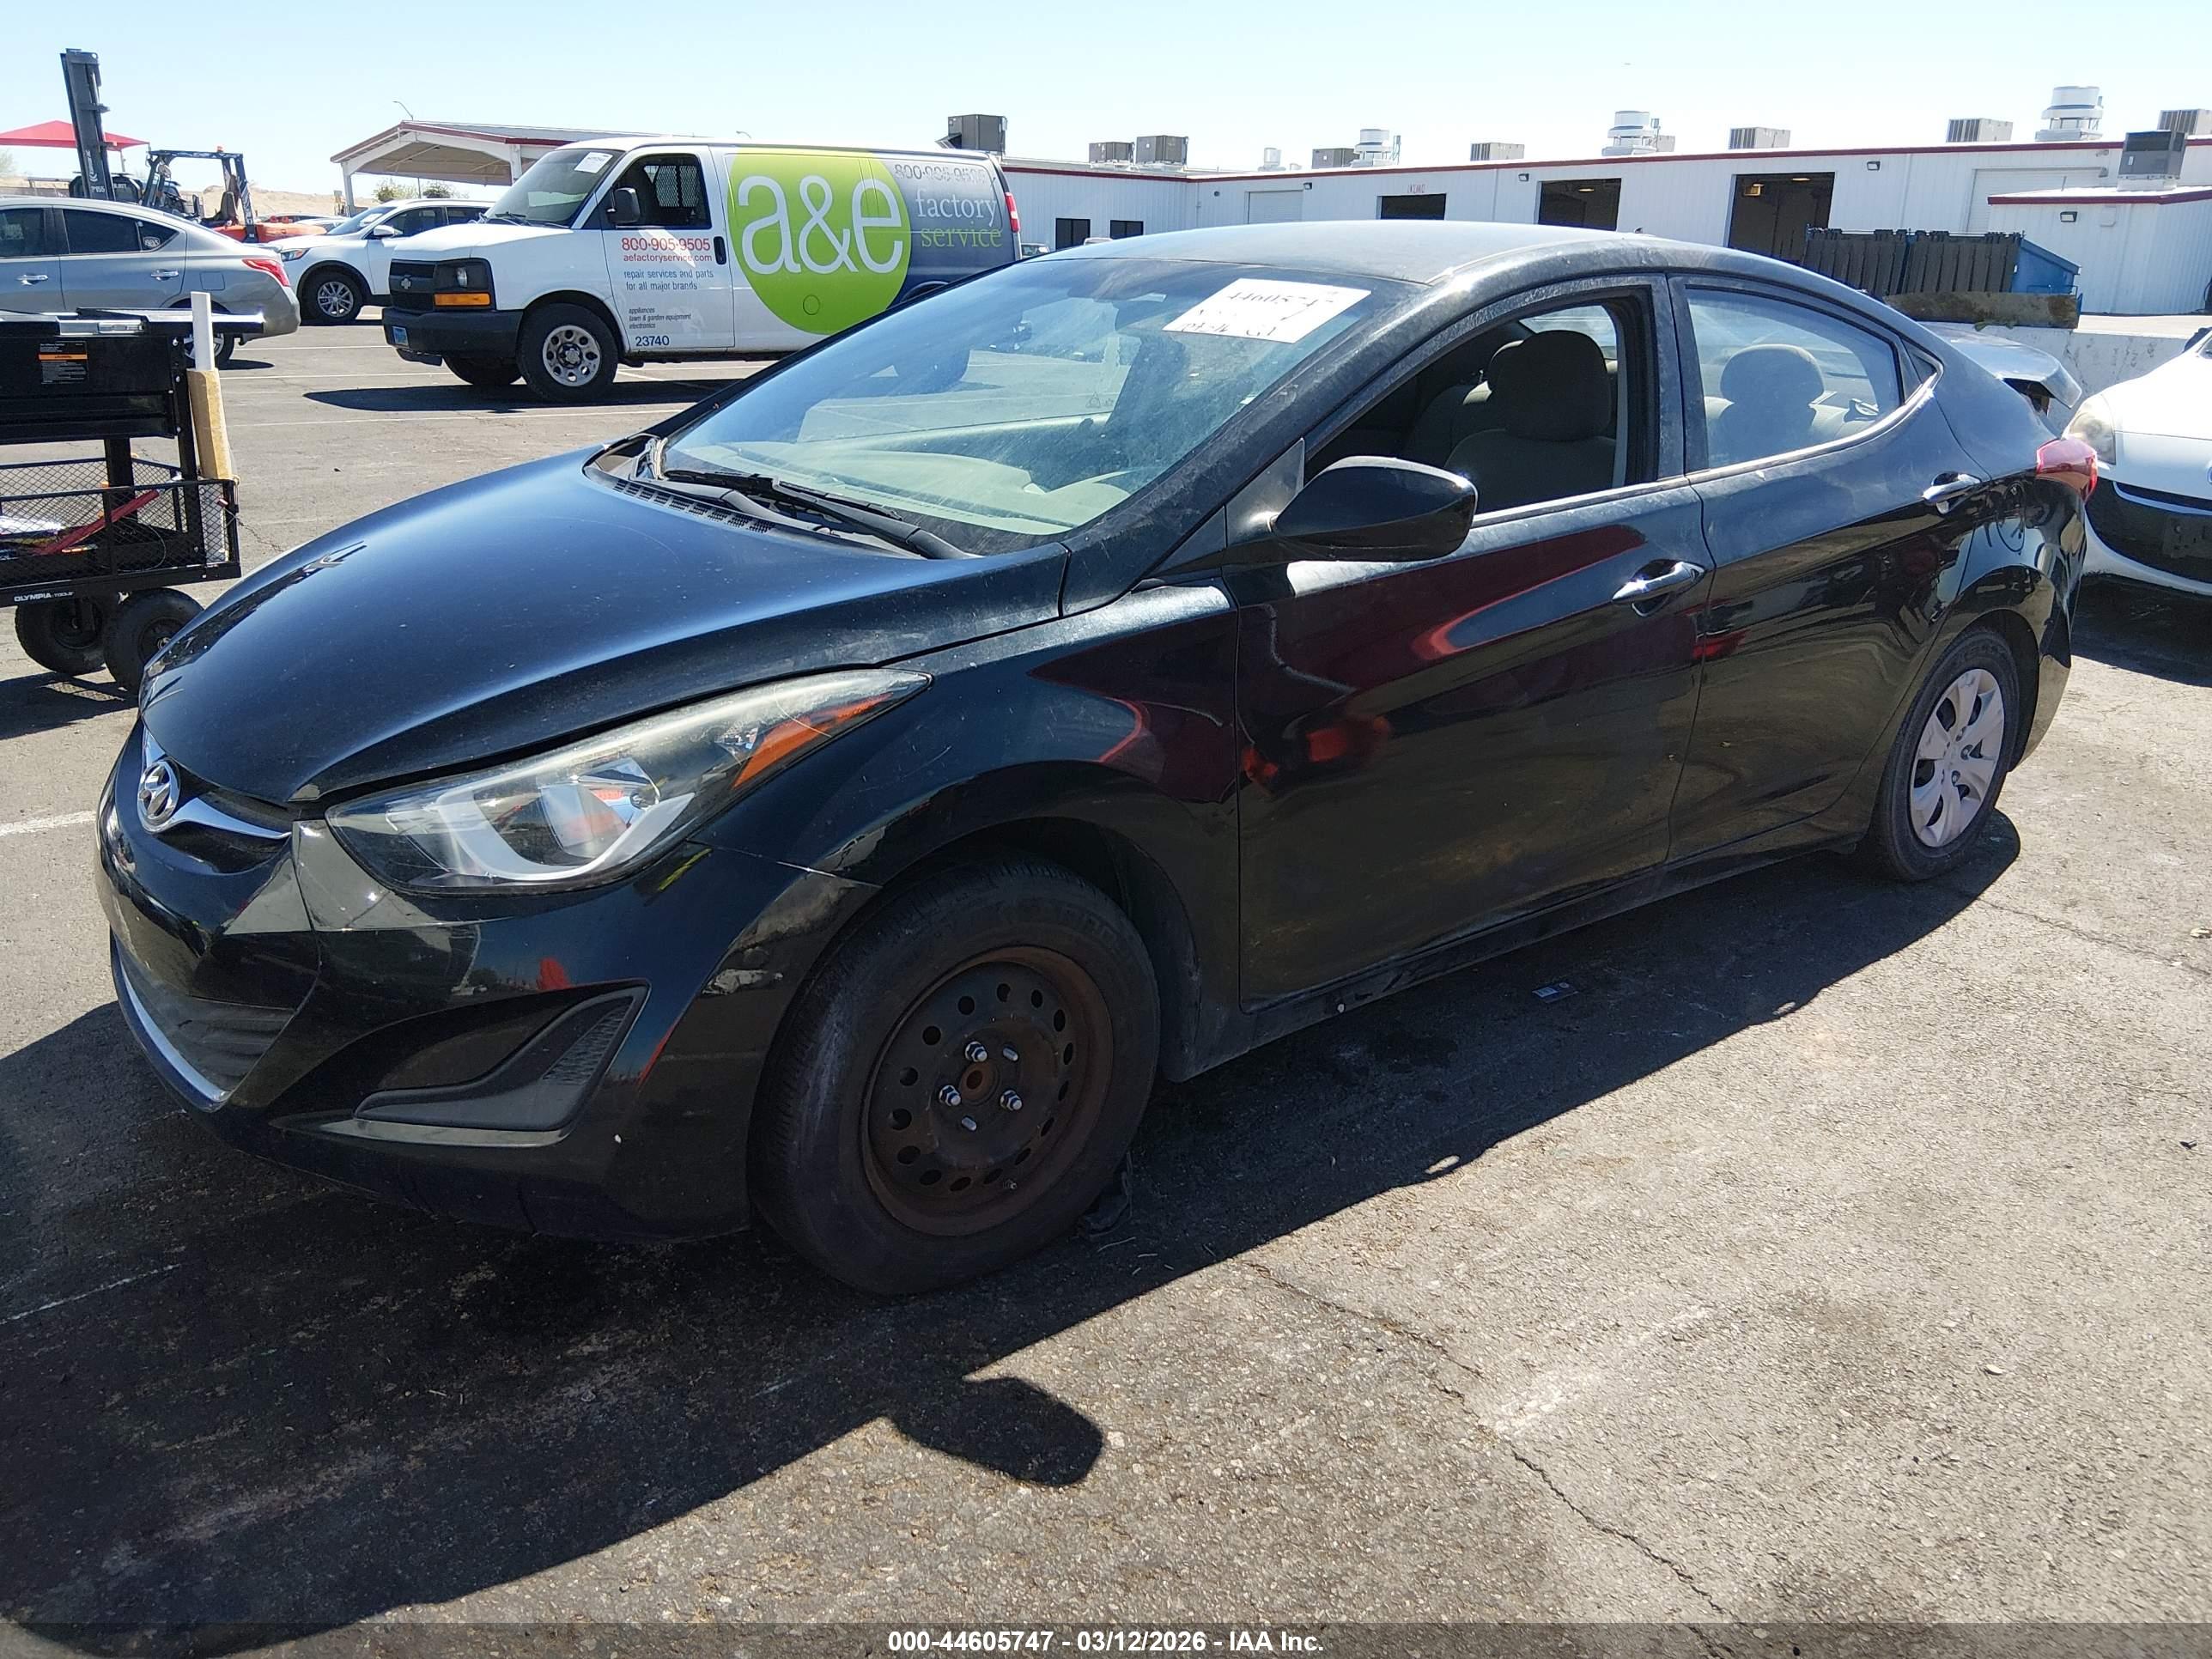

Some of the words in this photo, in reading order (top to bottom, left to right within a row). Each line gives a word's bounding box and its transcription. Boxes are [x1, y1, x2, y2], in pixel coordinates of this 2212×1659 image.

[915, 188, 997, 228] factory
[738, 174, 903, 275] a&e
[921, 221, 1003, 248] service
[623, 252, 712, 263] aefactoryservice.com
[623, 270, 645, 280] repair
[647, 270, 678, 278] services
[679, 269, 693, 278] and
[696, 268, 714, 280] parts
[626, 281, 635, 290] for
[638, 280, 647, 290] all
[650, 281, 670, 292] major
[672, 280, 697, 290] brands
[647, 314, 665, 323] garden
[665, 313, 691, 321] equipment
[635, 335, 670, 347] 23740
[14, 592, 52, 601] OLYMPIA
